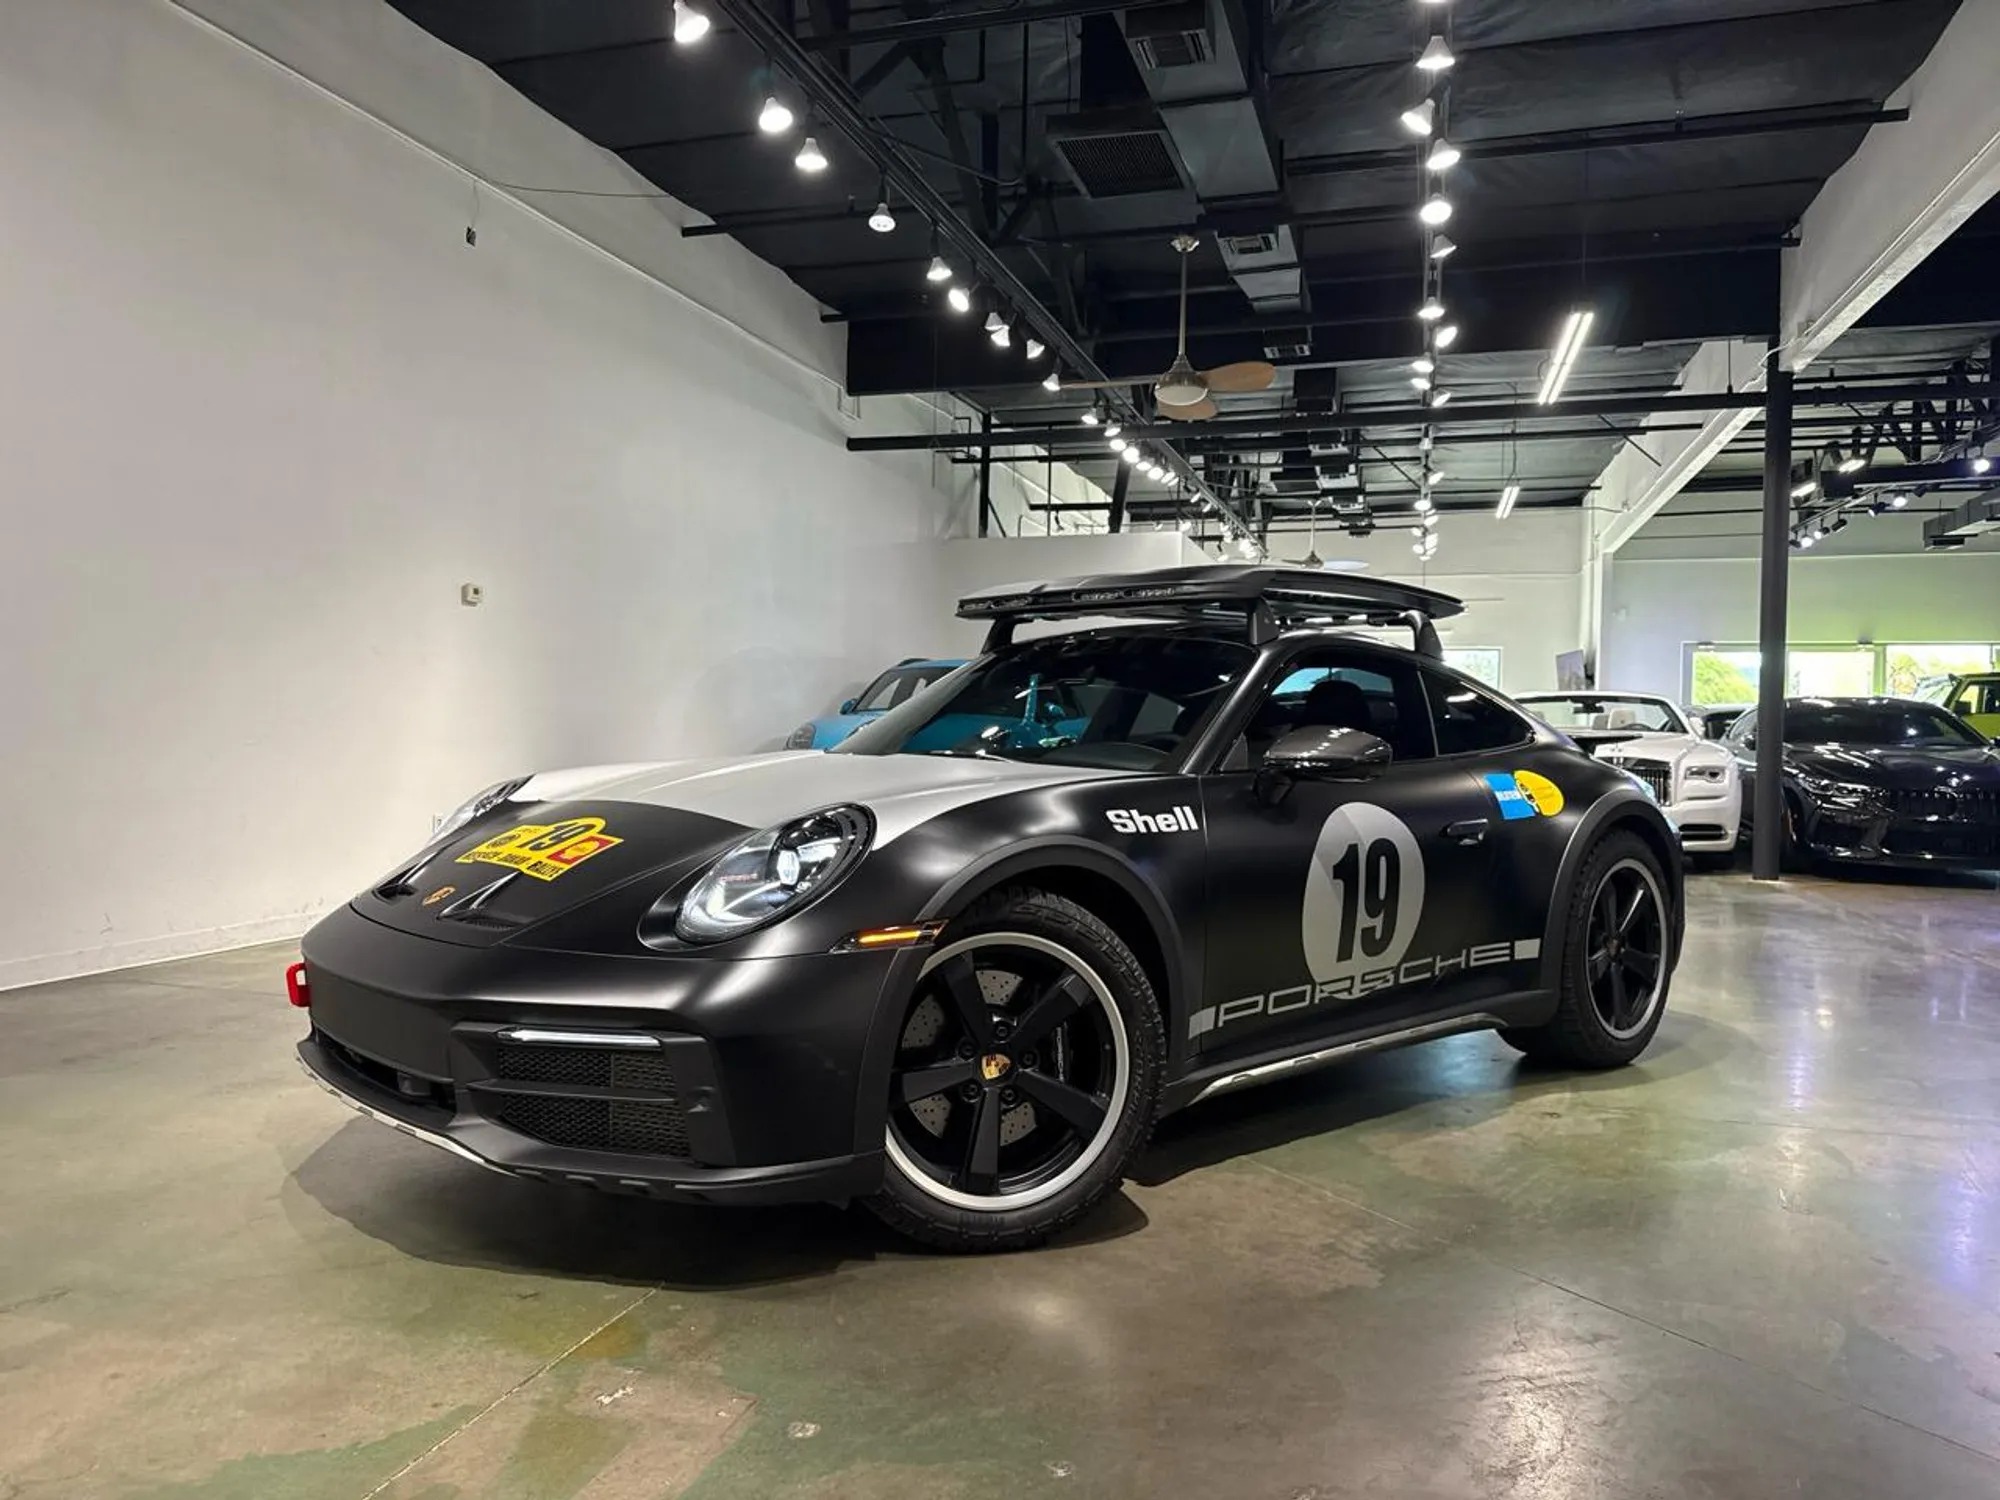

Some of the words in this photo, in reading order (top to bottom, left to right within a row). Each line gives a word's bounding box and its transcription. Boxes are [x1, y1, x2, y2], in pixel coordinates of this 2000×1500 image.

[515, 822, 597, 851] 19
[1106, 806, 1199, 833] Shell
[1332, 838, 1400, 963] 19
[1218, 941, 1511, 1028] PORSCHE
